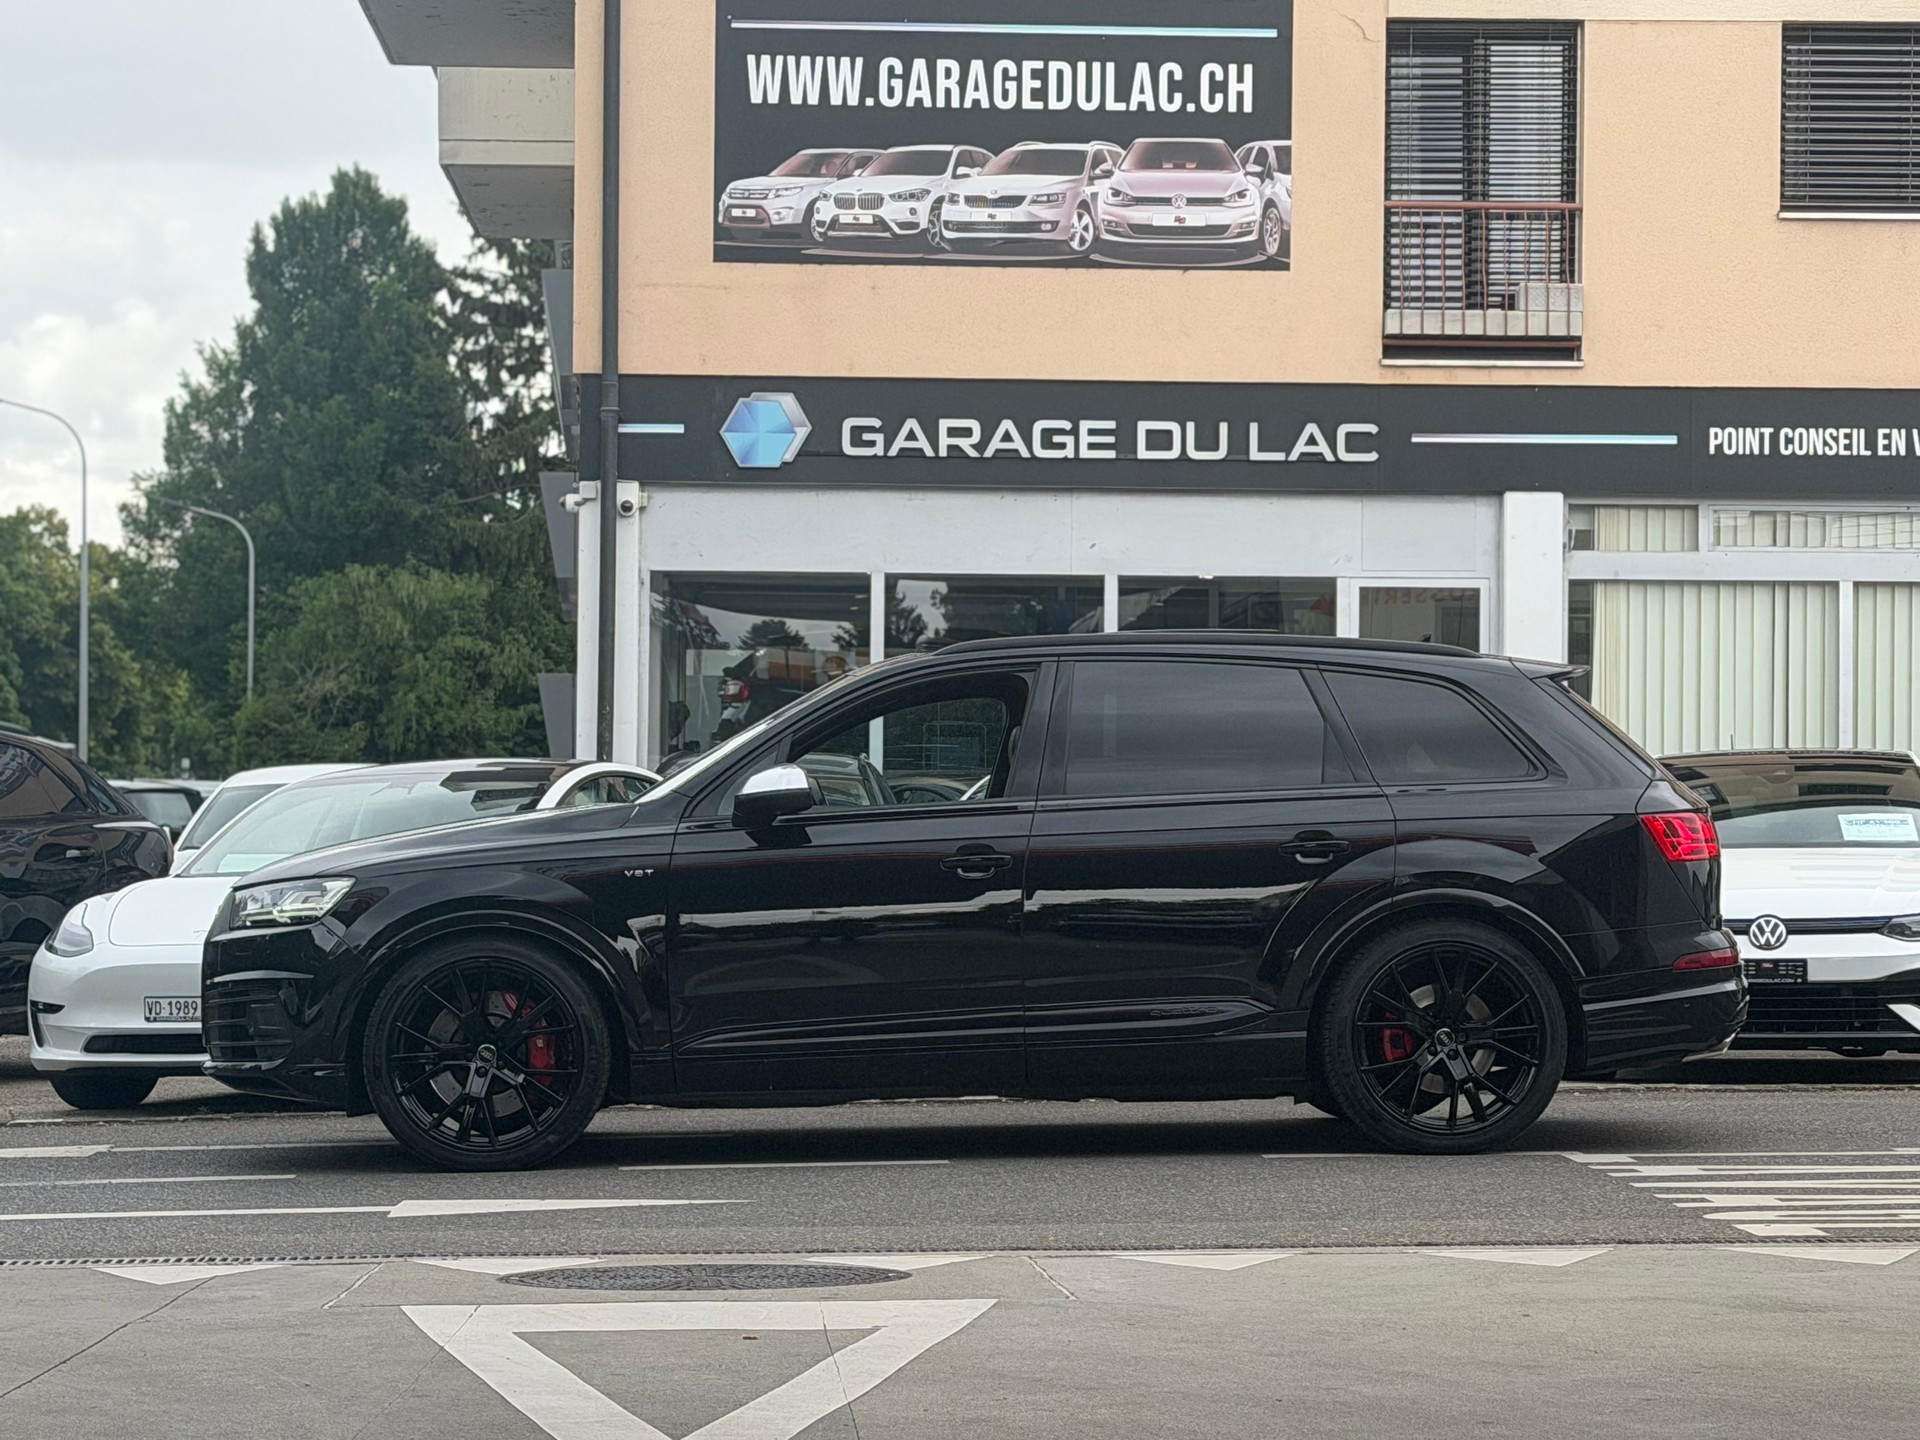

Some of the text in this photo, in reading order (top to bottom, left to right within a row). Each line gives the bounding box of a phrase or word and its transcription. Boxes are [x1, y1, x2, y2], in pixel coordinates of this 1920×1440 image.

[746, 54, 1254, 114] WWW.GARAGEDULAC.CH
[840, 417, 1380, 462] GARAGE DU LAC
[1708, 426, 1774, 456] POINT
[1779, 427, 1872, 457] CONSEIL
[1877, 428, 1907, 457] EN
